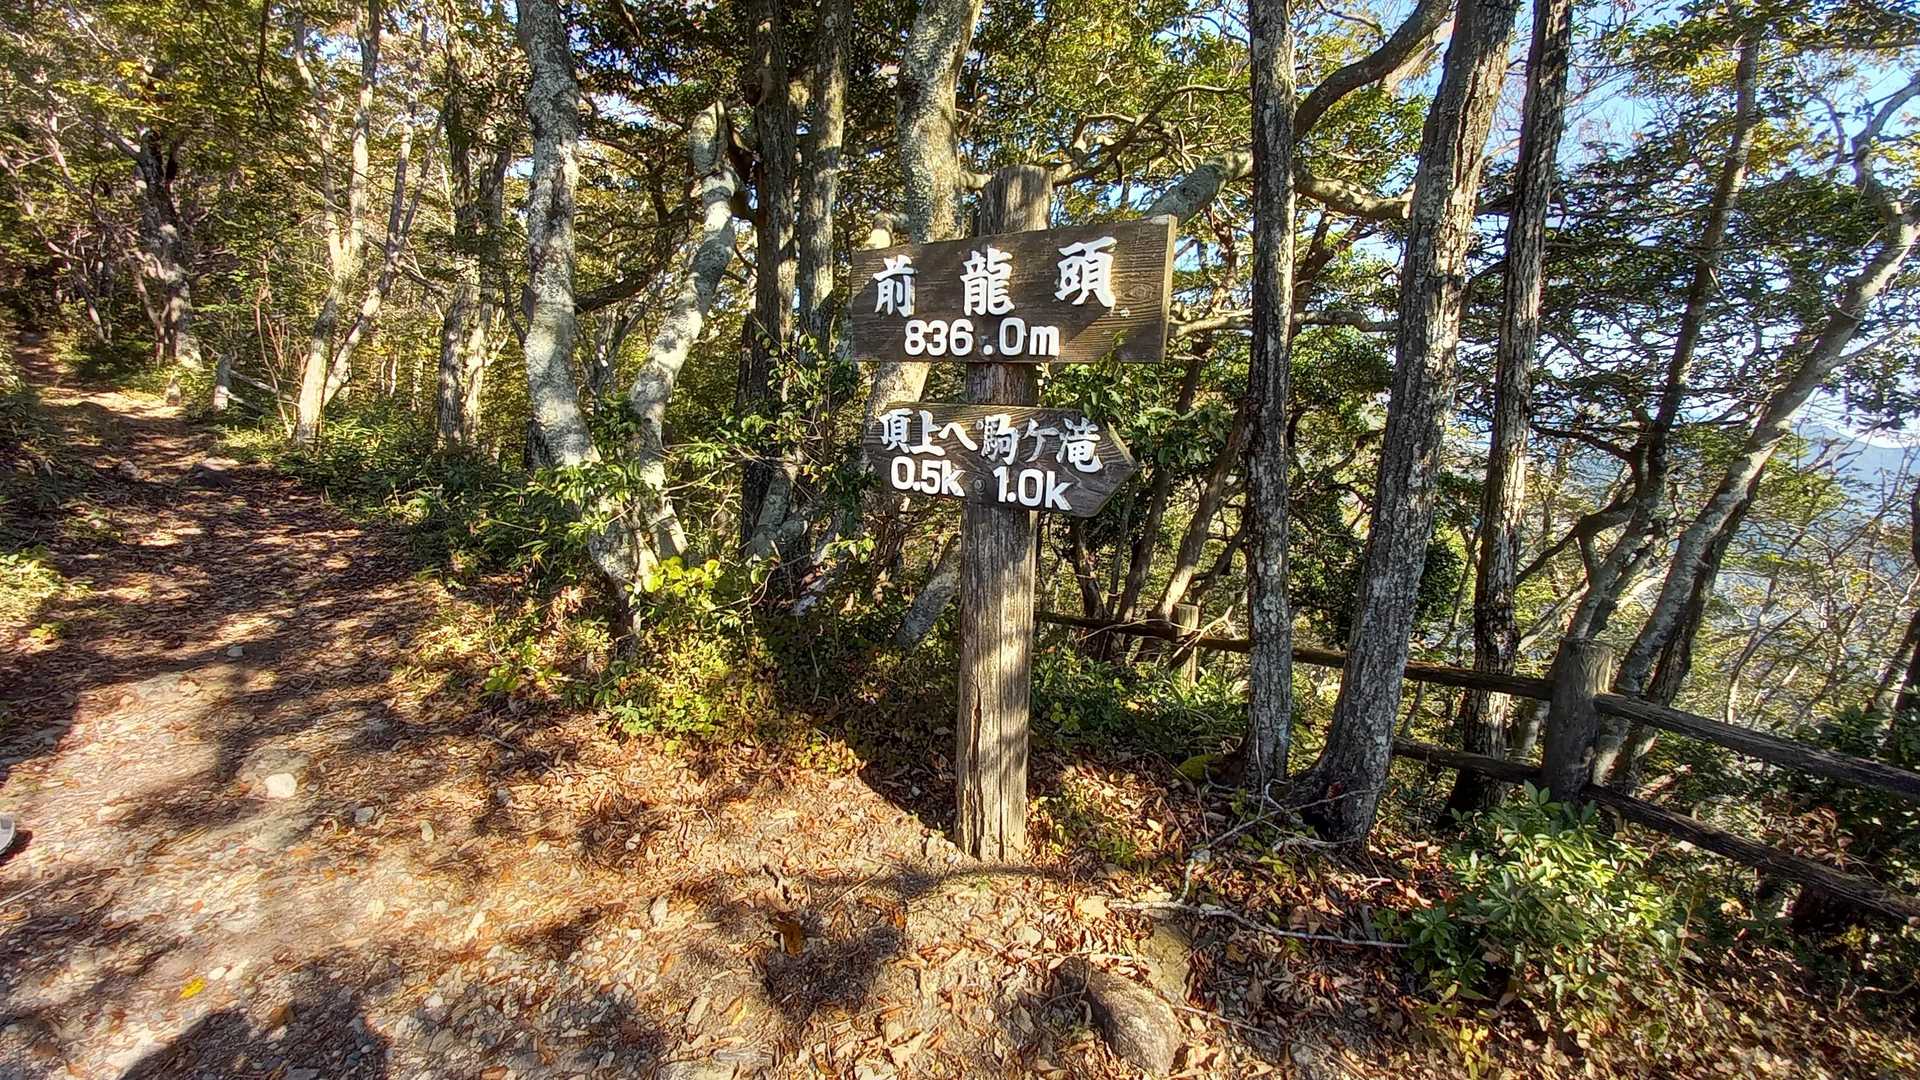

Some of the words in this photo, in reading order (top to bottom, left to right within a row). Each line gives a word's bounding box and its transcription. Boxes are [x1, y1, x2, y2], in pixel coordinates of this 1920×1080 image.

[873, 236, 1117, 318] 前龍頭
[904, 317, 1060, 357] 836.0m
[879, 407, 978, 456] 頂上へ
[890, 456, 967, 497] 0.5k
[992, 466, 1073, 511] 1.0k
